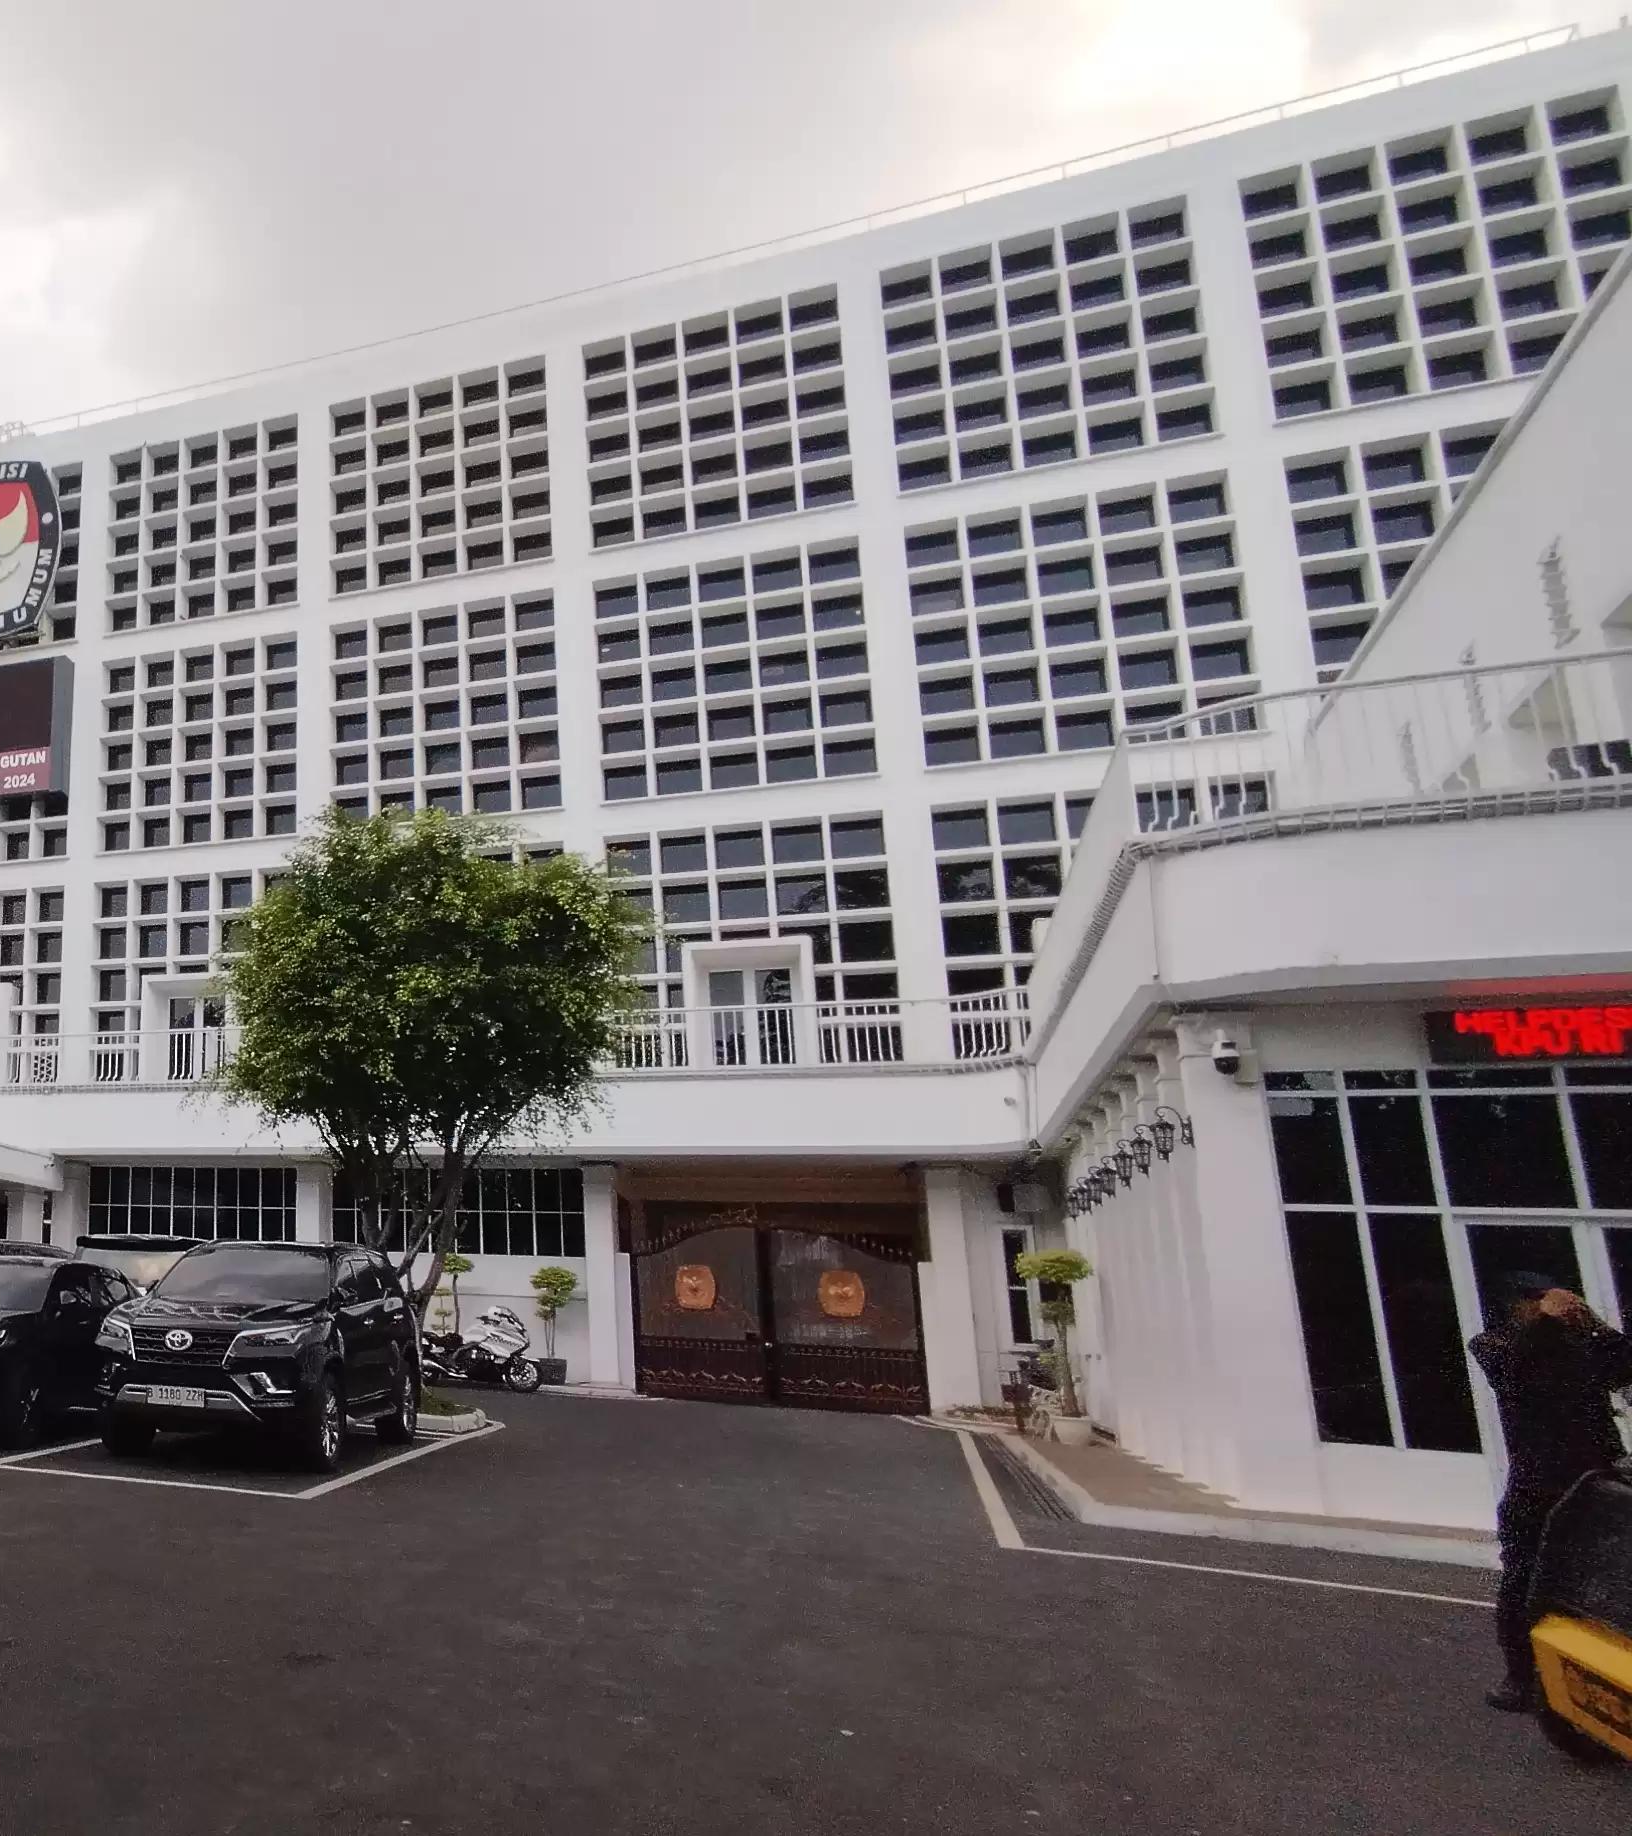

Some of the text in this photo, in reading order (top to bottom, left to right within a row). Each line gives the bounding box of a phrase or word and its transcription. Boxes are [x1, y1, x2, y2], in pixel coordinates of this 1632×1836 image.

[12, 547, 53, 624] UMUM
[3, 772, 36, 790] 2024
[1493, 1028, 1625, 1056] KPU RI
[147, 1387, 154, 1398] B
